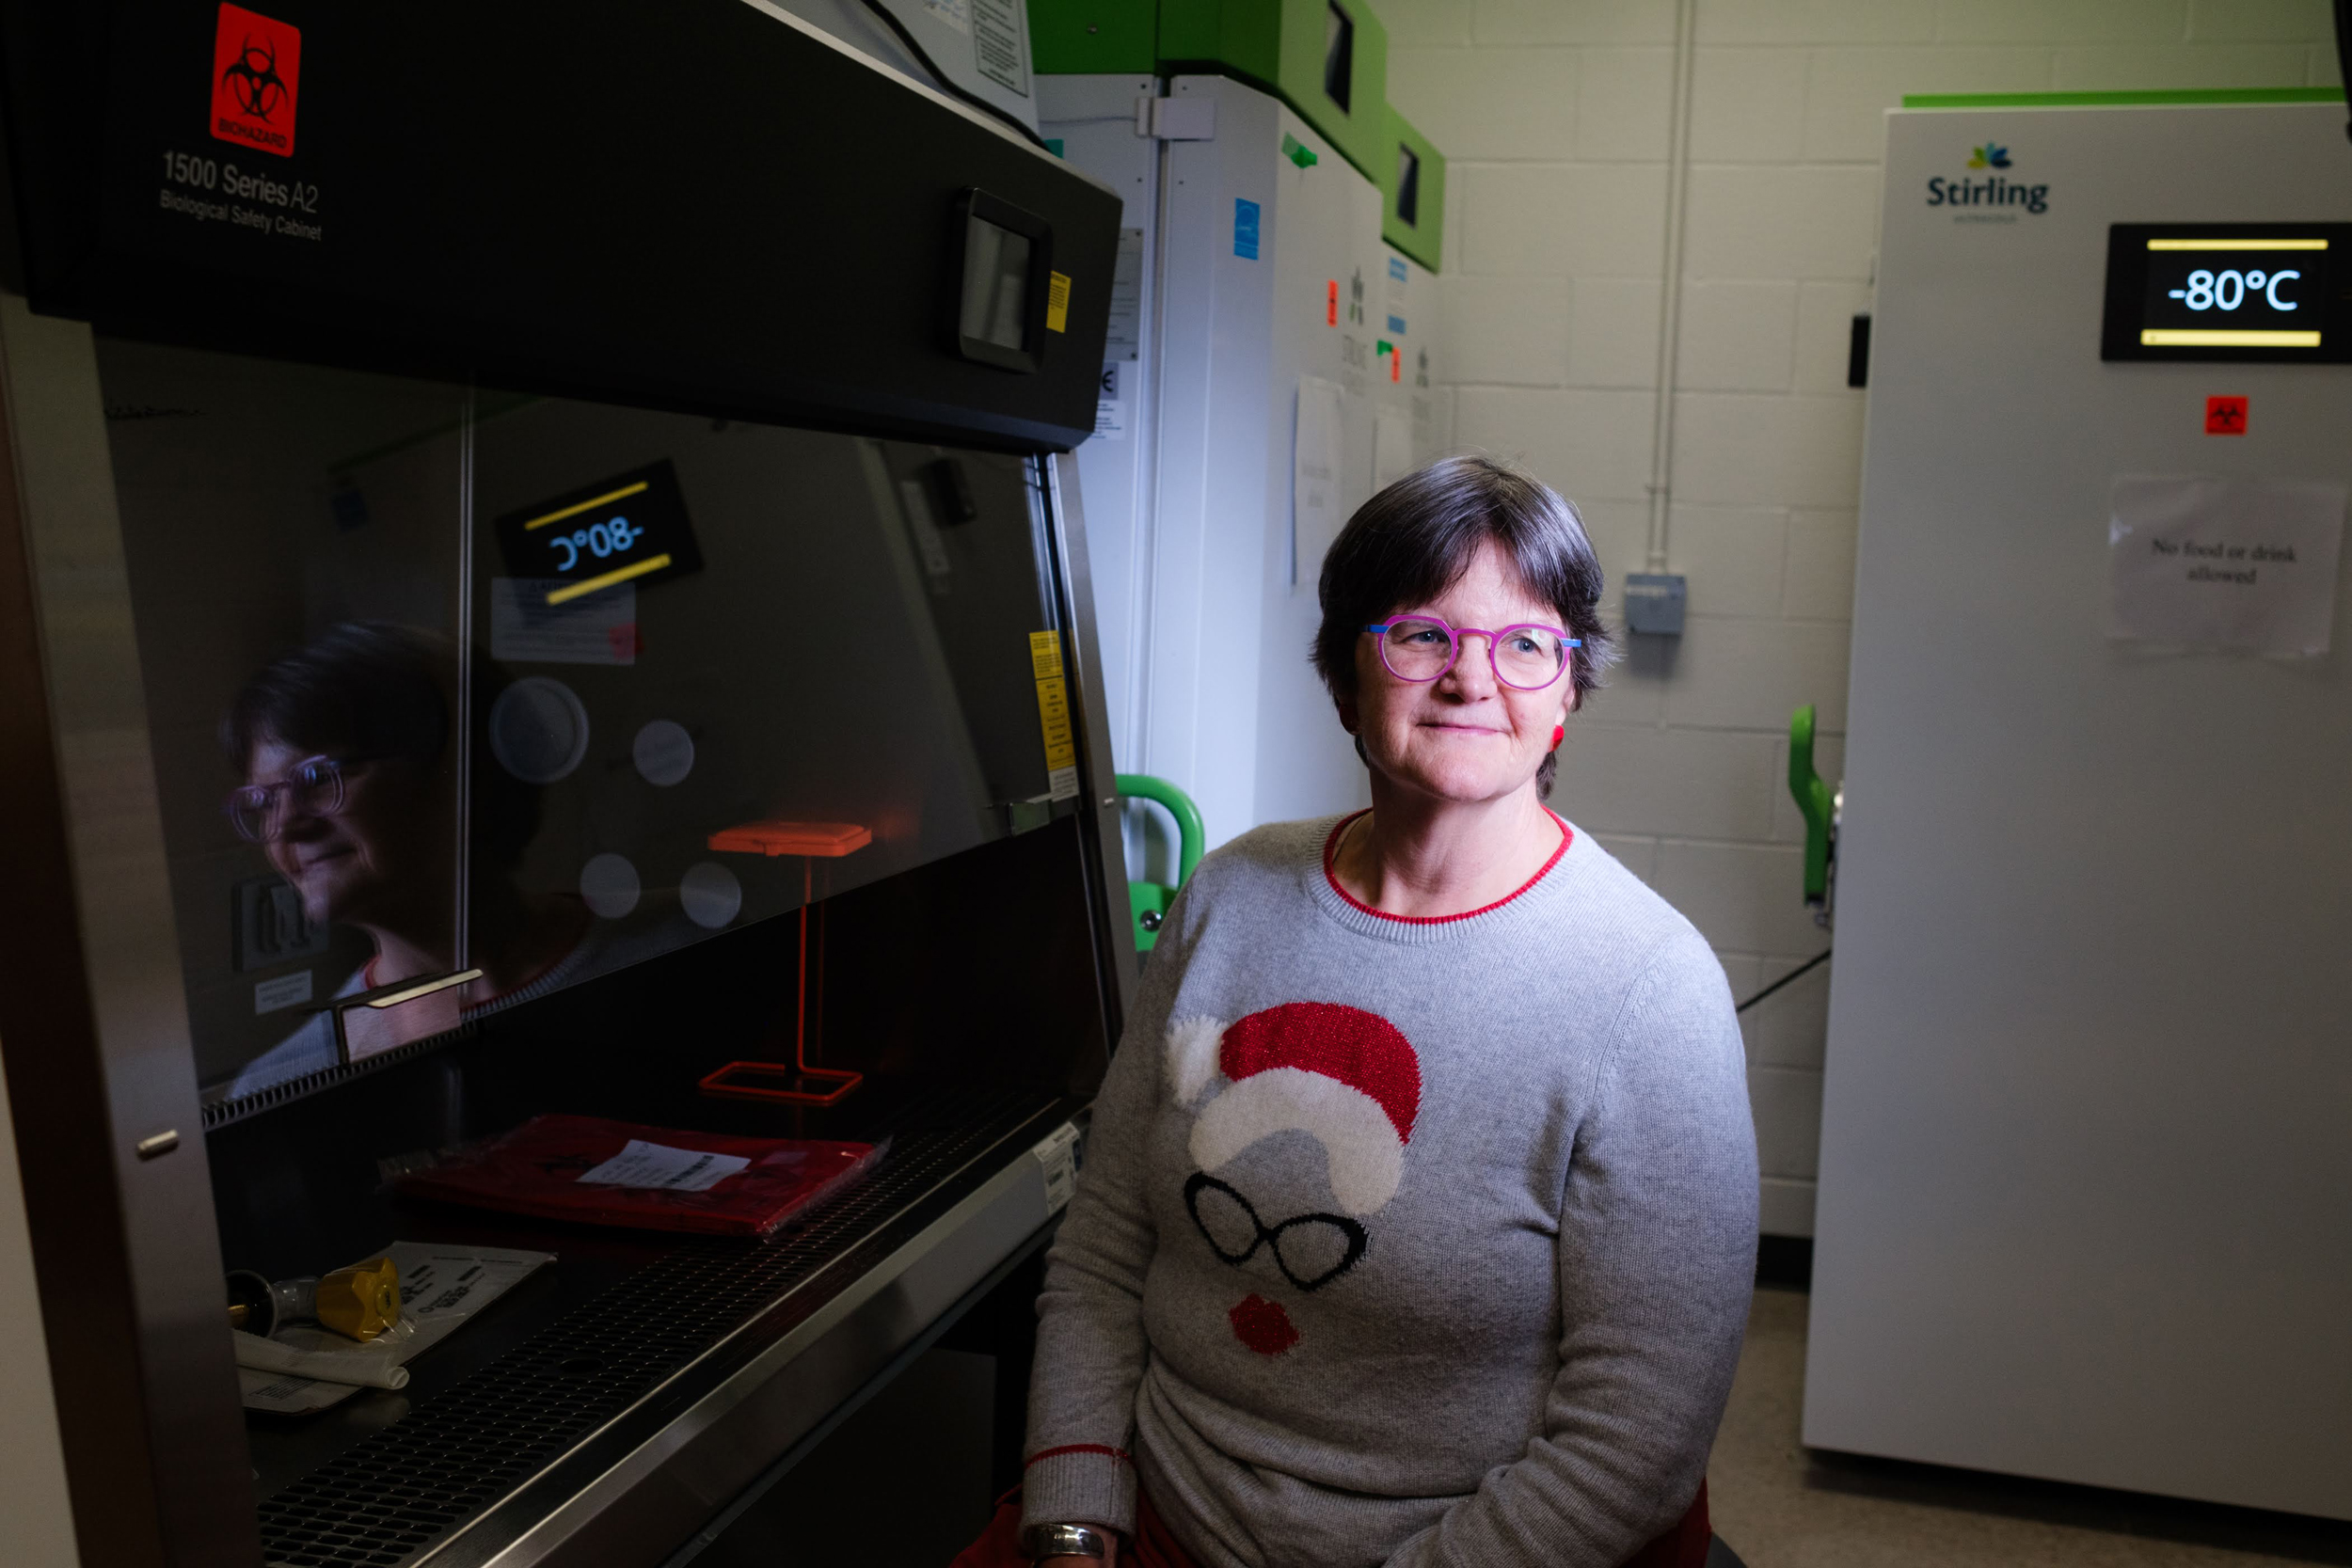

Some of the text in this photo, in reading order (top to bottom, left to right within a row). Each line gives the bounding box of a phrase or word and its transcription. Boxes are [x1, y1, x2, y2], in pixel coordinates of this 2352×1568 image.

[219, 119, 287, 148] BIOHAZARD
[162, 150, 320, 214] 1500 Series A2
[1927, 176, 2049, 214] Stirling
[159, 188, 323, 242] Biological Safety Cabinet
[2168, 269, 2301, 311] -80°C
[2150, 537, 2297, 563] No food or drink
[2185, 566, 2258, 585] allowed
